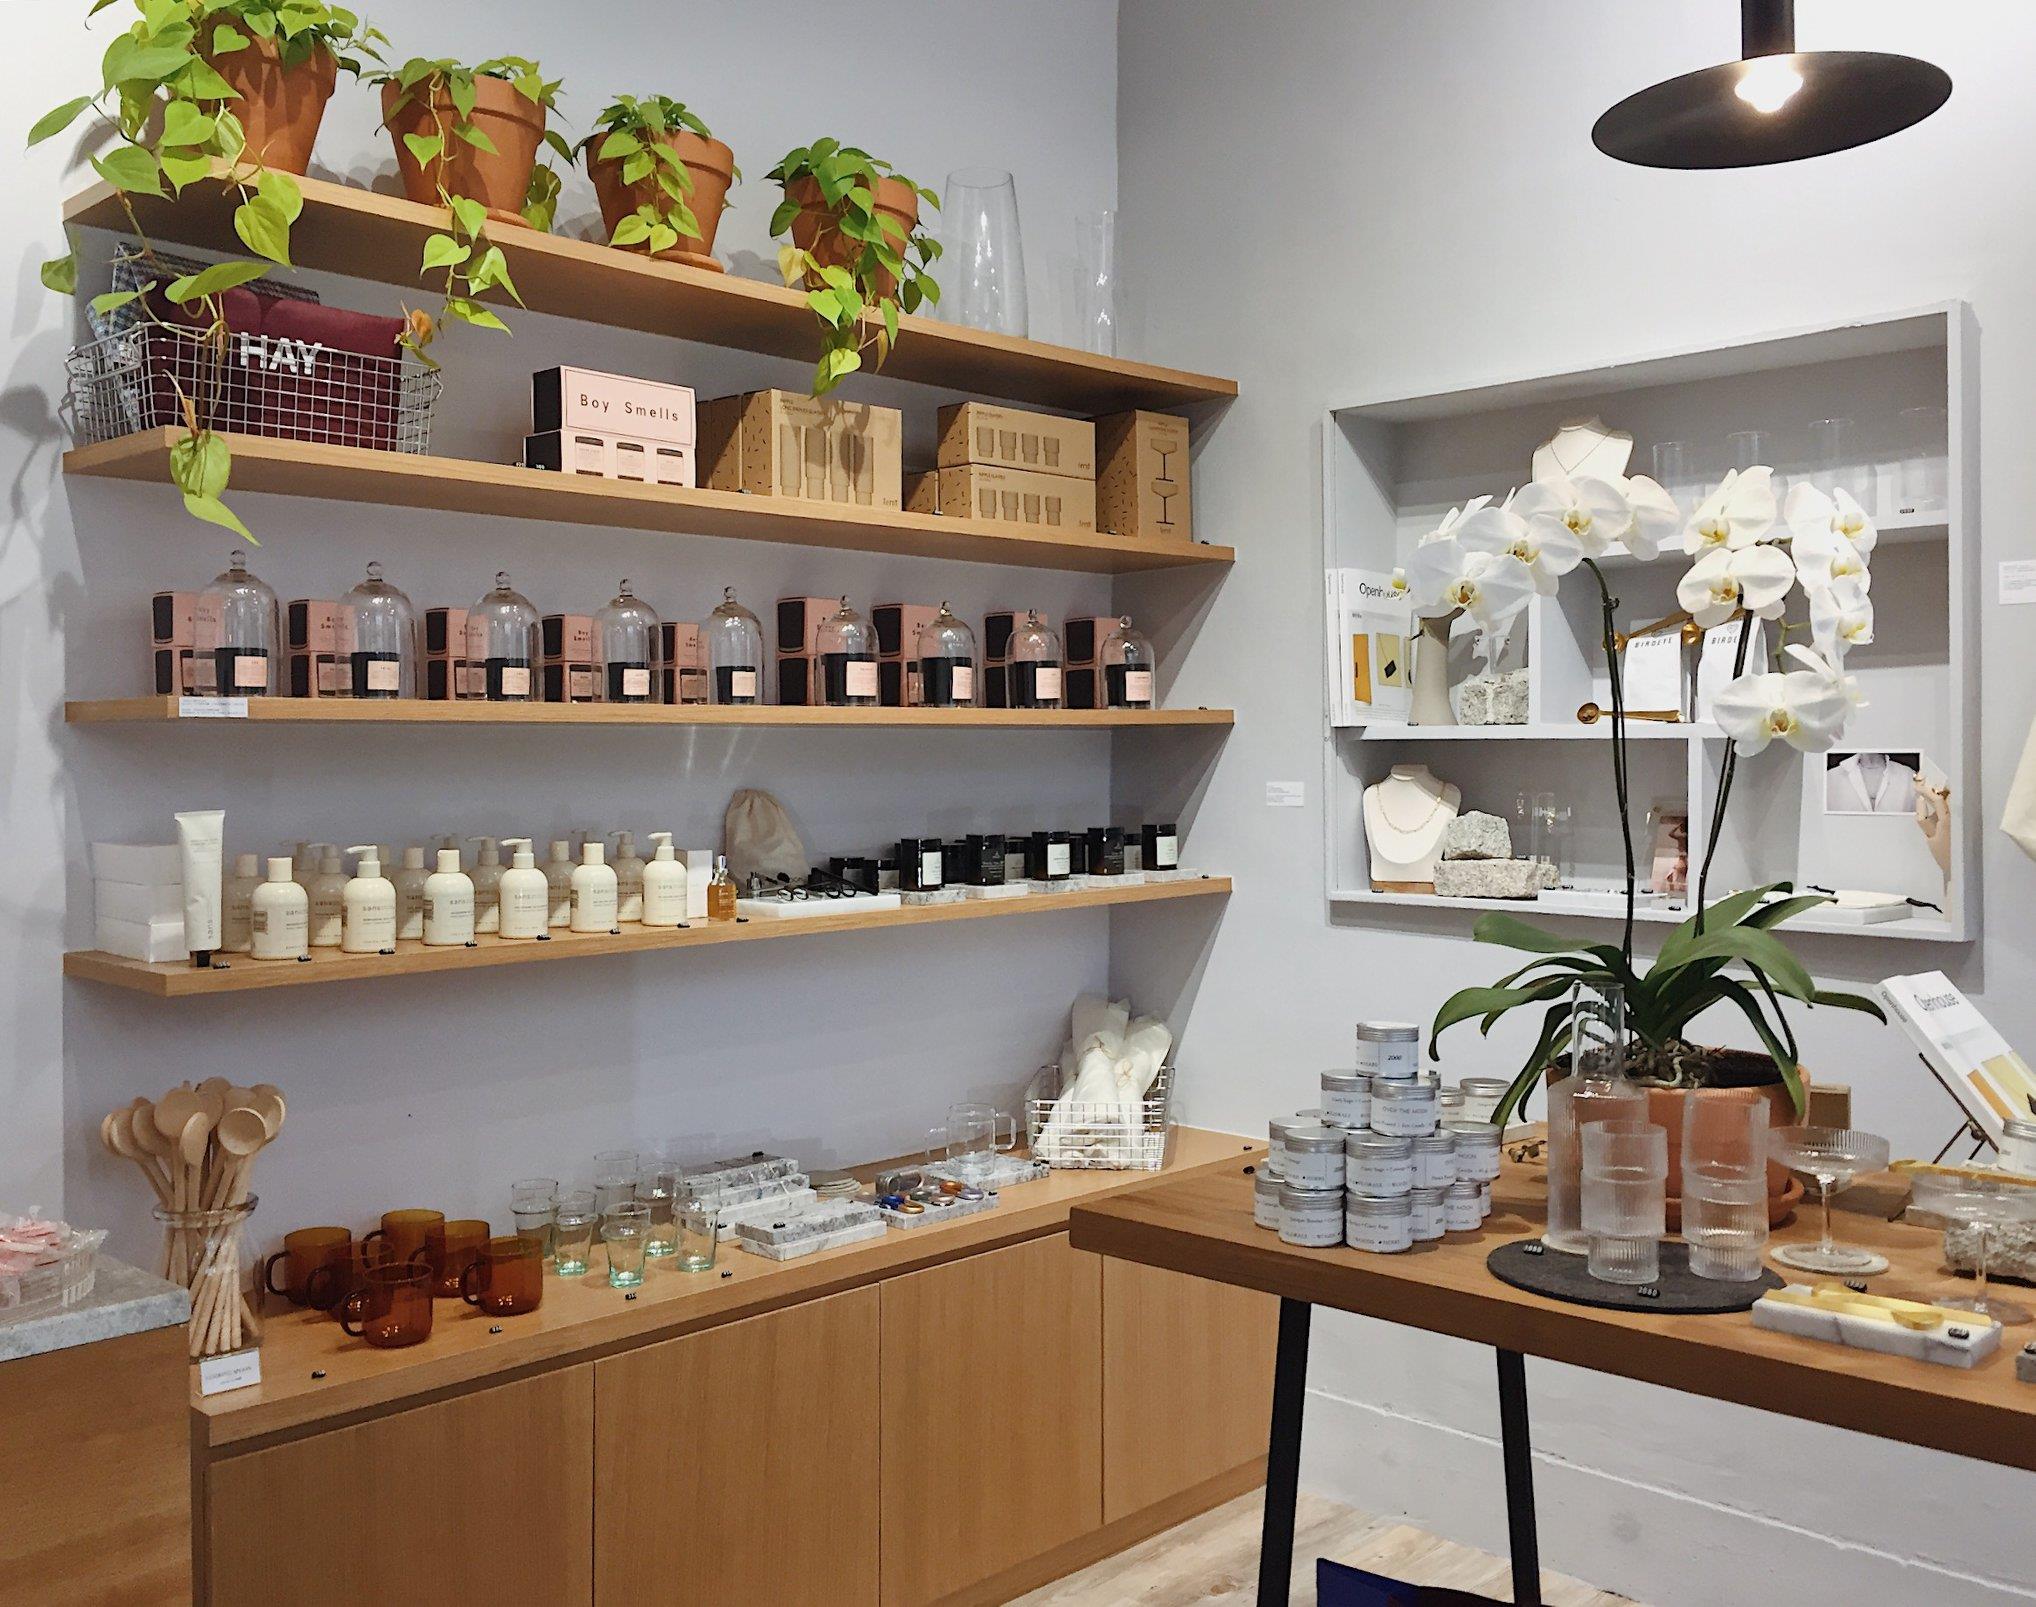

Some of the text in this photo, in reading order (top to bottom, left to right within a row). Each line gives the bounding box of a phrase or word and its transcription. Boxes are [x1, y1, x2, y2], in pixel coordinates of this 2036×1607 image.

[240, 331, 322, 375] HAY
[580, 393, 679, 422] Boy Smells
